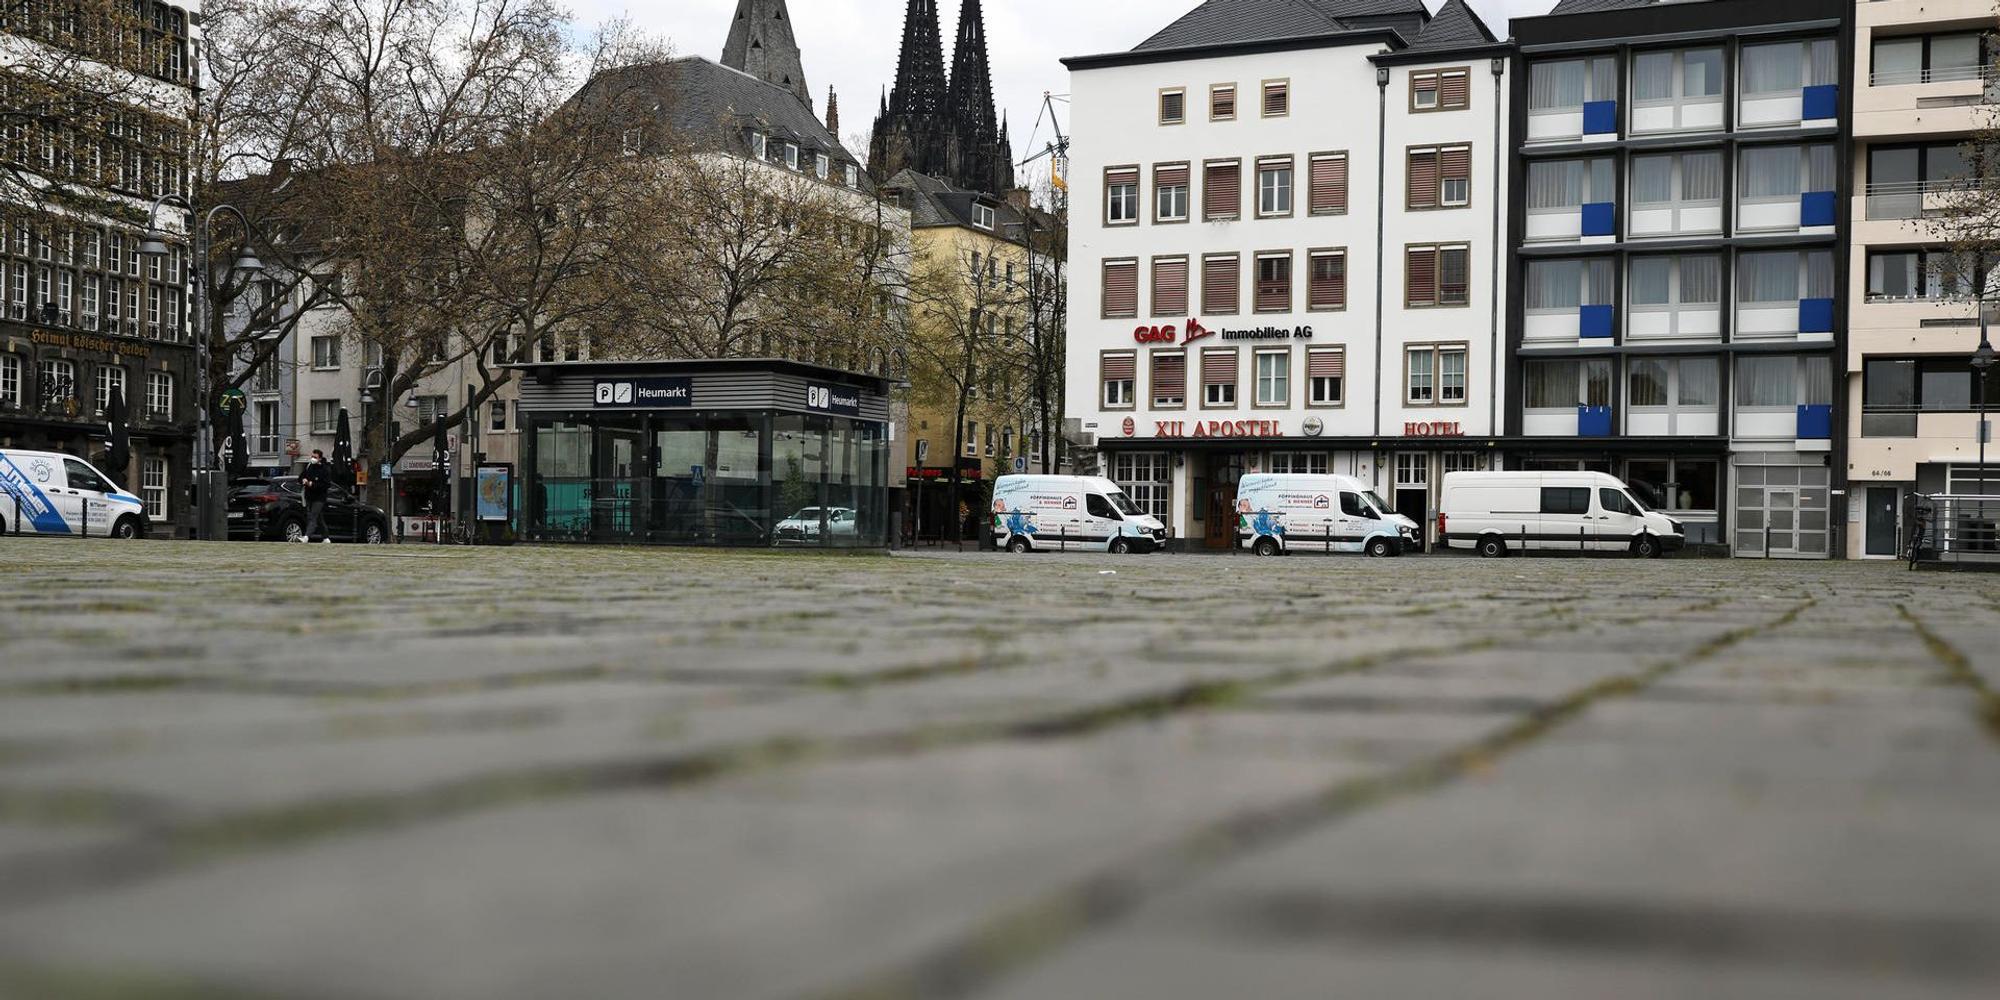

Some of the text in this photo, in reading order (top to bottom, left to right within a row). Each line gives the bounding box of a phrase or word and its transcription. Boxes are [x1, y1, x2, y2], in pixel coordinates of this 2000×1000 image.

[1134, 325, 1313, 343] GAG Immobilien AG
[638, 387, 687, 398] Heumarkt
[832, 394, 858, 407] Heumarkt
[1154, 420, 1184, 437] XII
[1191, 420, 1283, 437] APOSTEL
[1403, 421, 1464, 438] HOTEL
